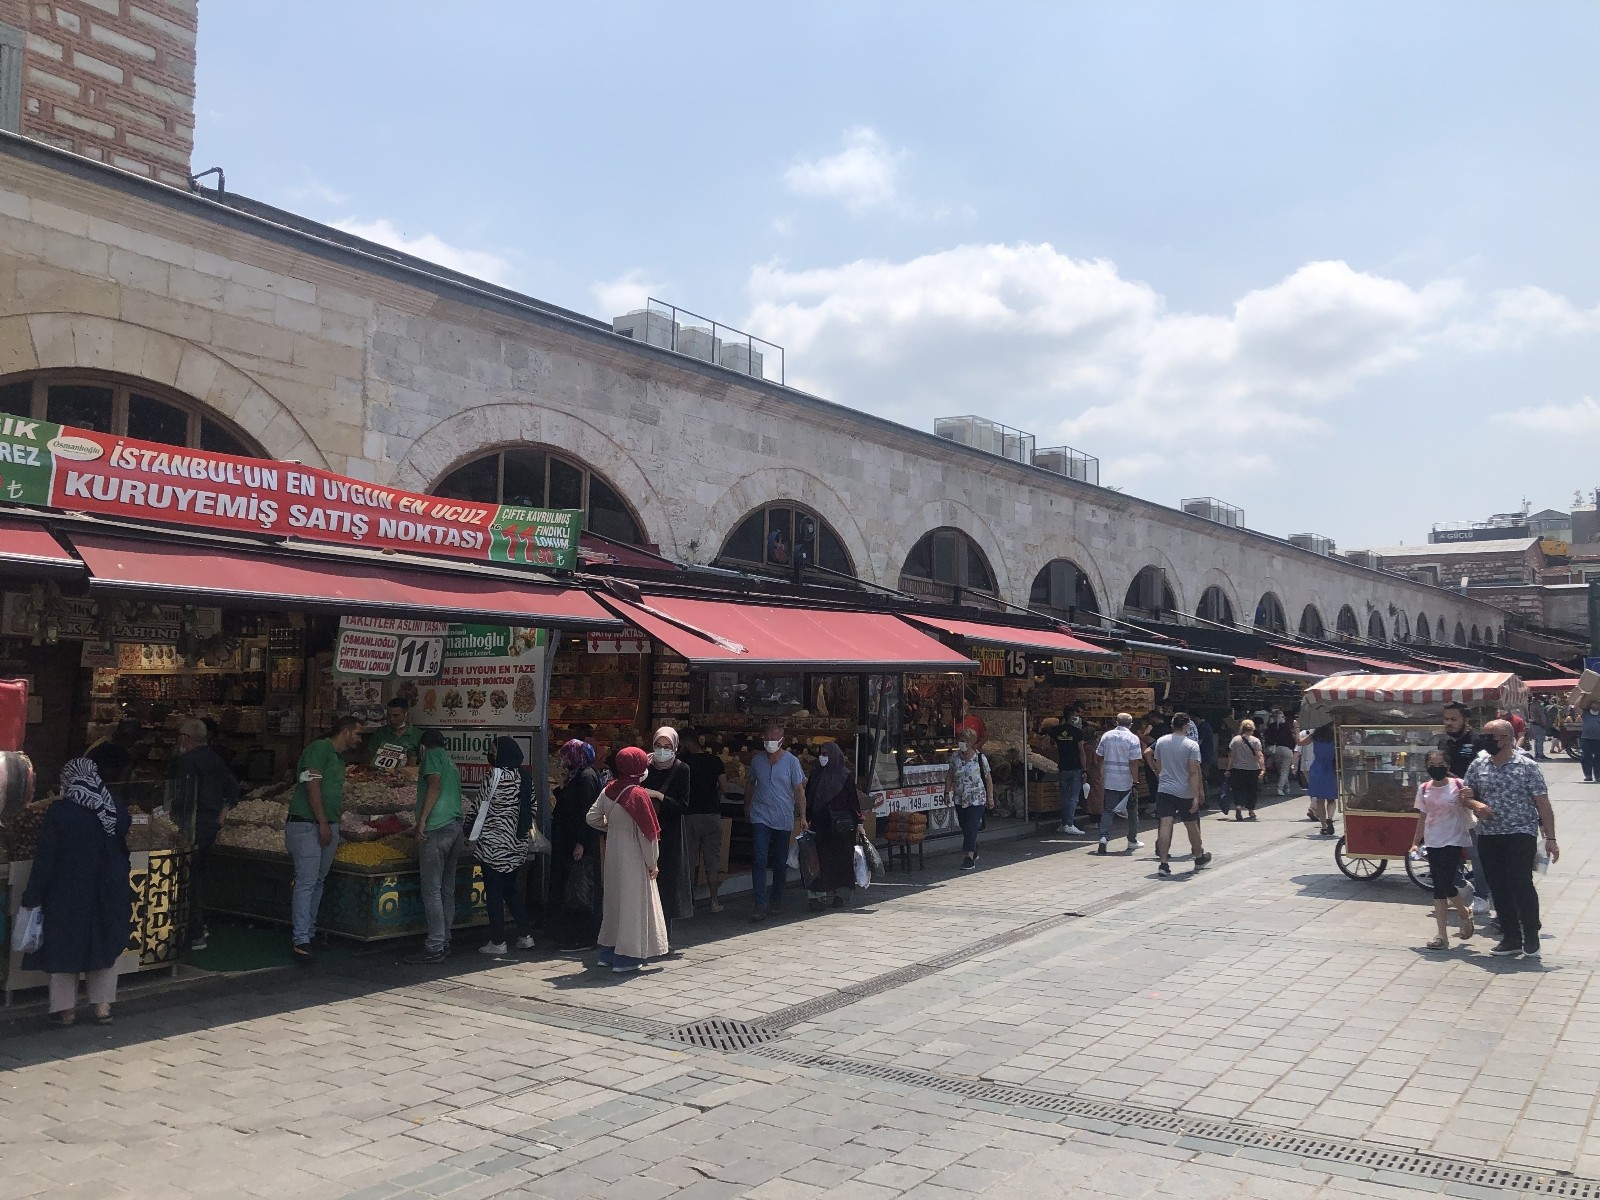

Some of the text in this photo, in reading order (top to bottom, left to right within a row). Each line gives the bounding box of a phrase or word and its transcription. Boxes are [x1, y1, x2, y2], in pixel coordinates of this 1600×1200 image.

[109, 440, 488, 525] İSTANBUL'UN EN UYGUN EN UCUZ
[65, 470, 484, 550] KURUYEMİŞ SATIŞ NOKTASI
[343, 634, 397, 649] OSMANLIOĞLU
[452, 666, 464, 675] EN
[466, 665, 496, 675] UYGUN
[498, 665, 511, 674] EN
[513, 664, 536, 674] TAZE
[1007, 650, 1026, 675] 15
[377, 757, 394, 768] 40
[909, 797, 922, 810] 149
